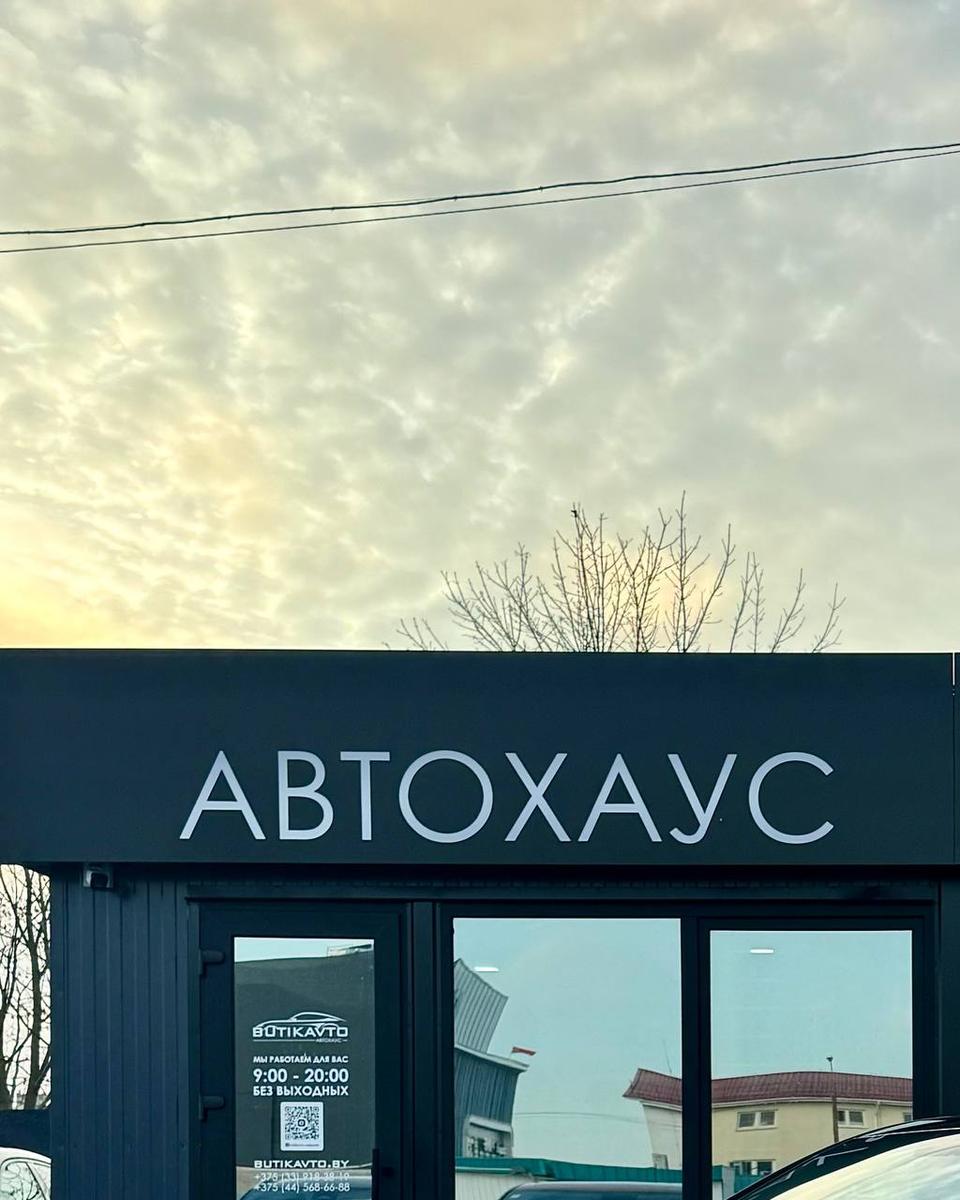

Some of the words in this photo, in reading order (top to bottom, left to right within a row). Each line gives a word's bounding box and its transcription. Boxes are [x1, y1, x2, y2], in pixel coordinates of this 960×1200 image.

[179, 749, 835, 844] АВТОХАУС
[252, 1027, 348, 1038] BUTIKAVTO
[252, 1056, 268, 1064] МЫ
[269, 1056, 312, 1064] РАБОТАЕМ
[313, 1056, 330, 1065] ДЛЯ
[331, 1056, 349, 1064] ВАС
[253, 1068, 288, 1083] 9:00
[304, 1068, 349, 1083] 20:00
[253, 1085, 273, 1096] БЕЗ
[276, 1085, 349, 1097] ВЫХОДНЫХ
[254, 1159, 350, 1169] BUTIKAVTO.BY
[254, 1183, 279, 1192] +375
[281, 1182, 300, 1194] (44)
[303, 1183, 351, 1192] 568-66-88
